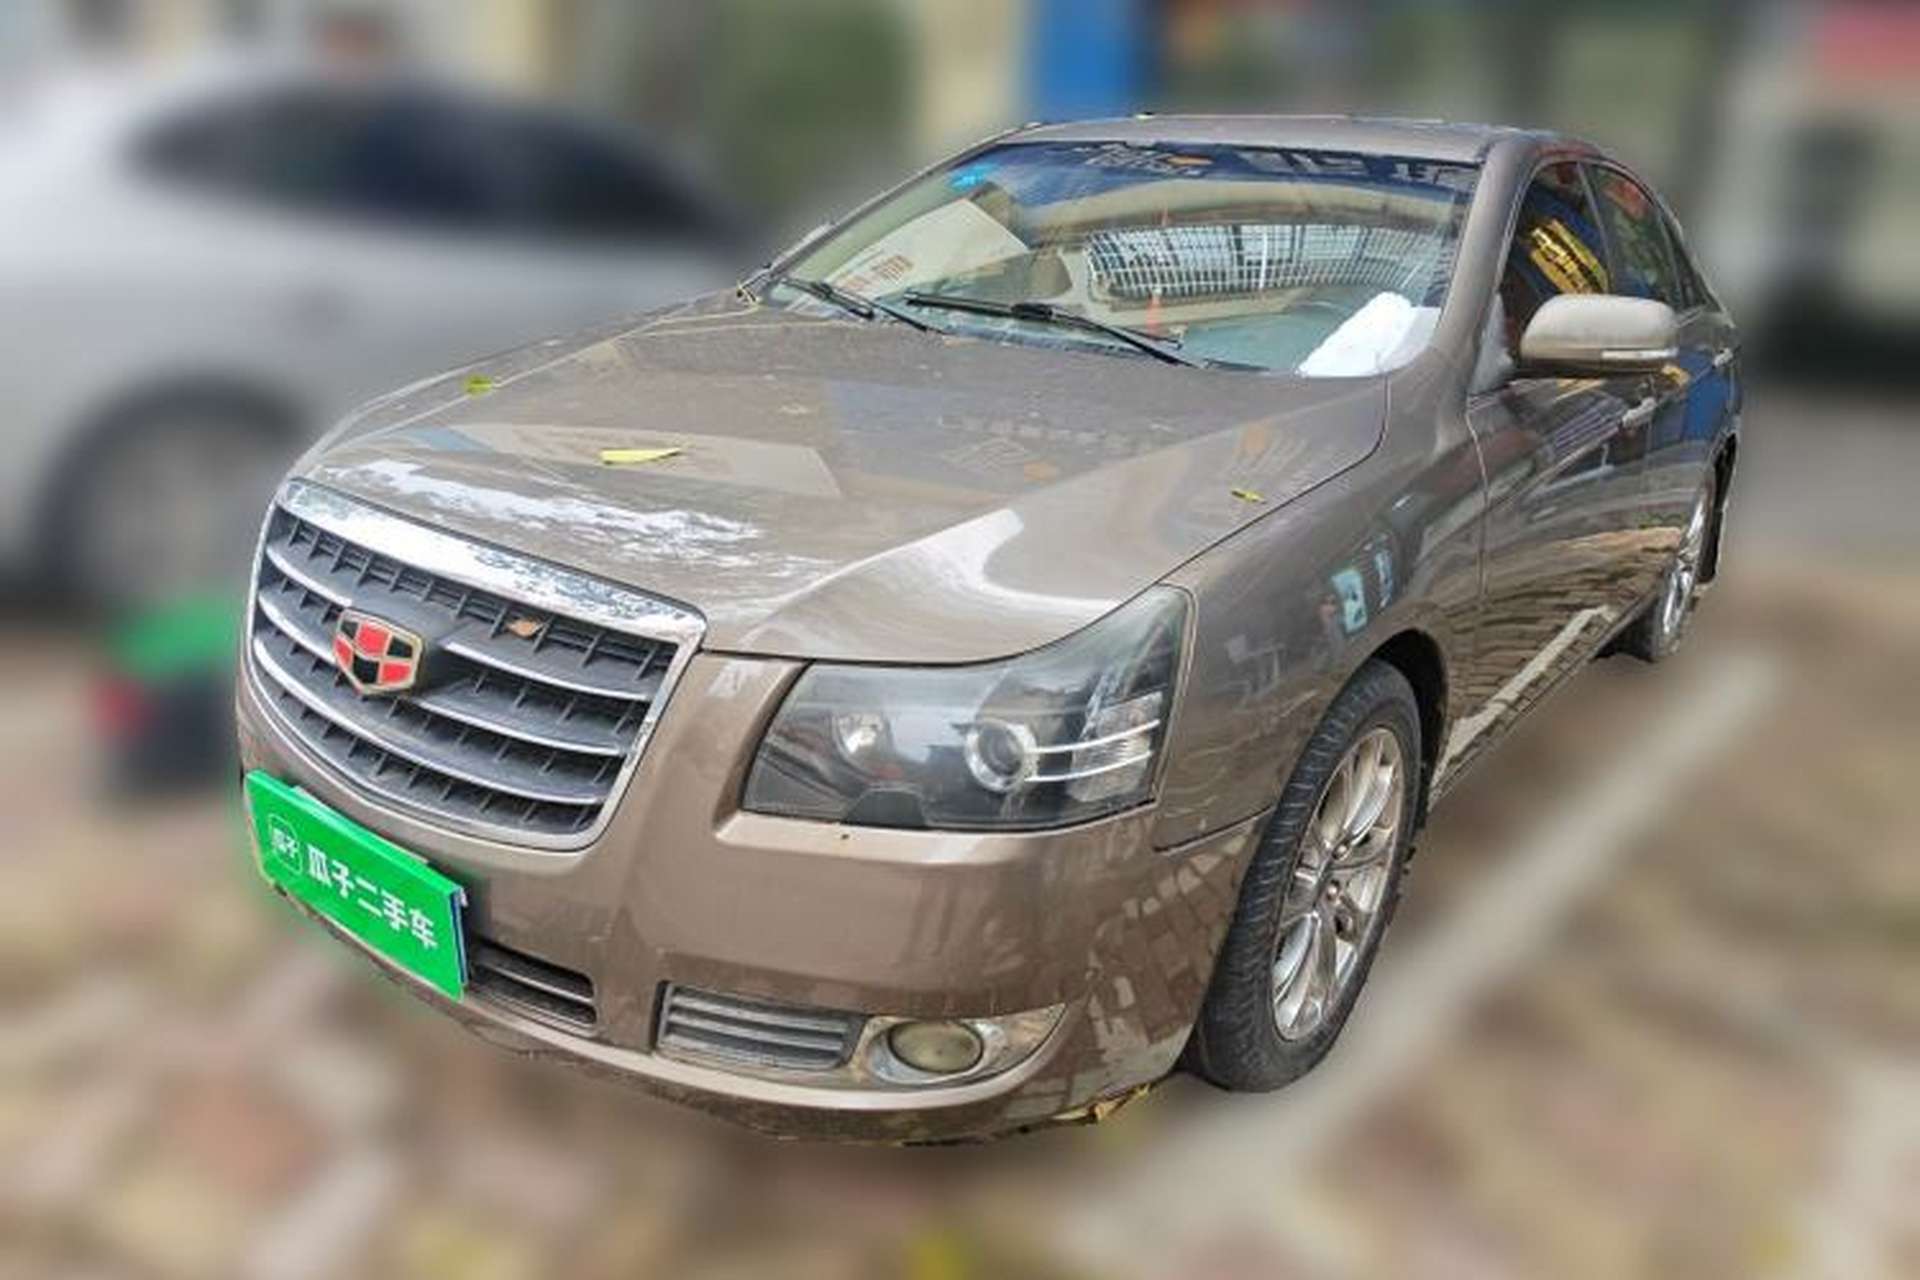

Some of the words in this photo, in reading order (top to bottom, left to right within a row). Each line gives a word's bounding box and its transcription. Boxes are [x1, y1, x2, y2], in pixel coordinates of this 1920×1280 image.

[307, 844, 438, 950] 瓜子二手车
